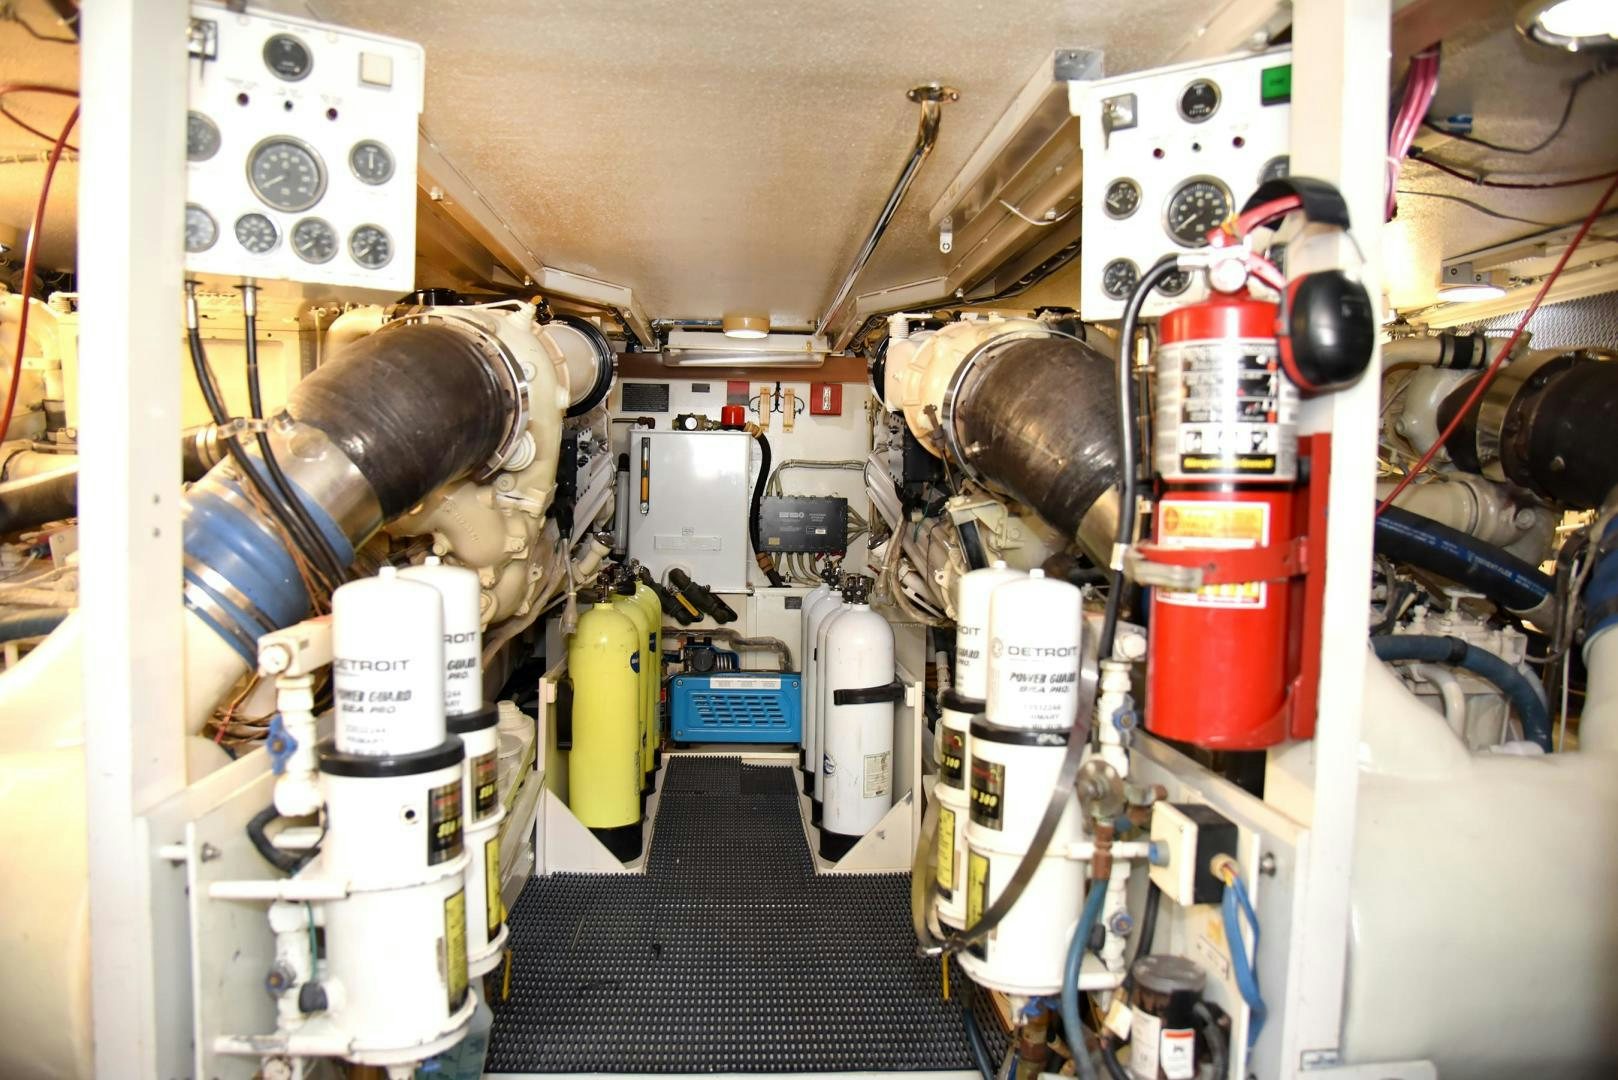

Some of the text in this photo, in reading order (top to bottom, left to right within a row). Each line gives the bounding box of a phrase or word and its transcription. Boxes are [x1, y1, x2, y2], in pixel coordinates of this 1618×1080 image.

[443, 632, 476, 644] ROIT
[1008, 646, 1078, 657] DETROIT
[1009, 672, 1047, 684] POWER
[368, 690, 412, 702] GUARD
